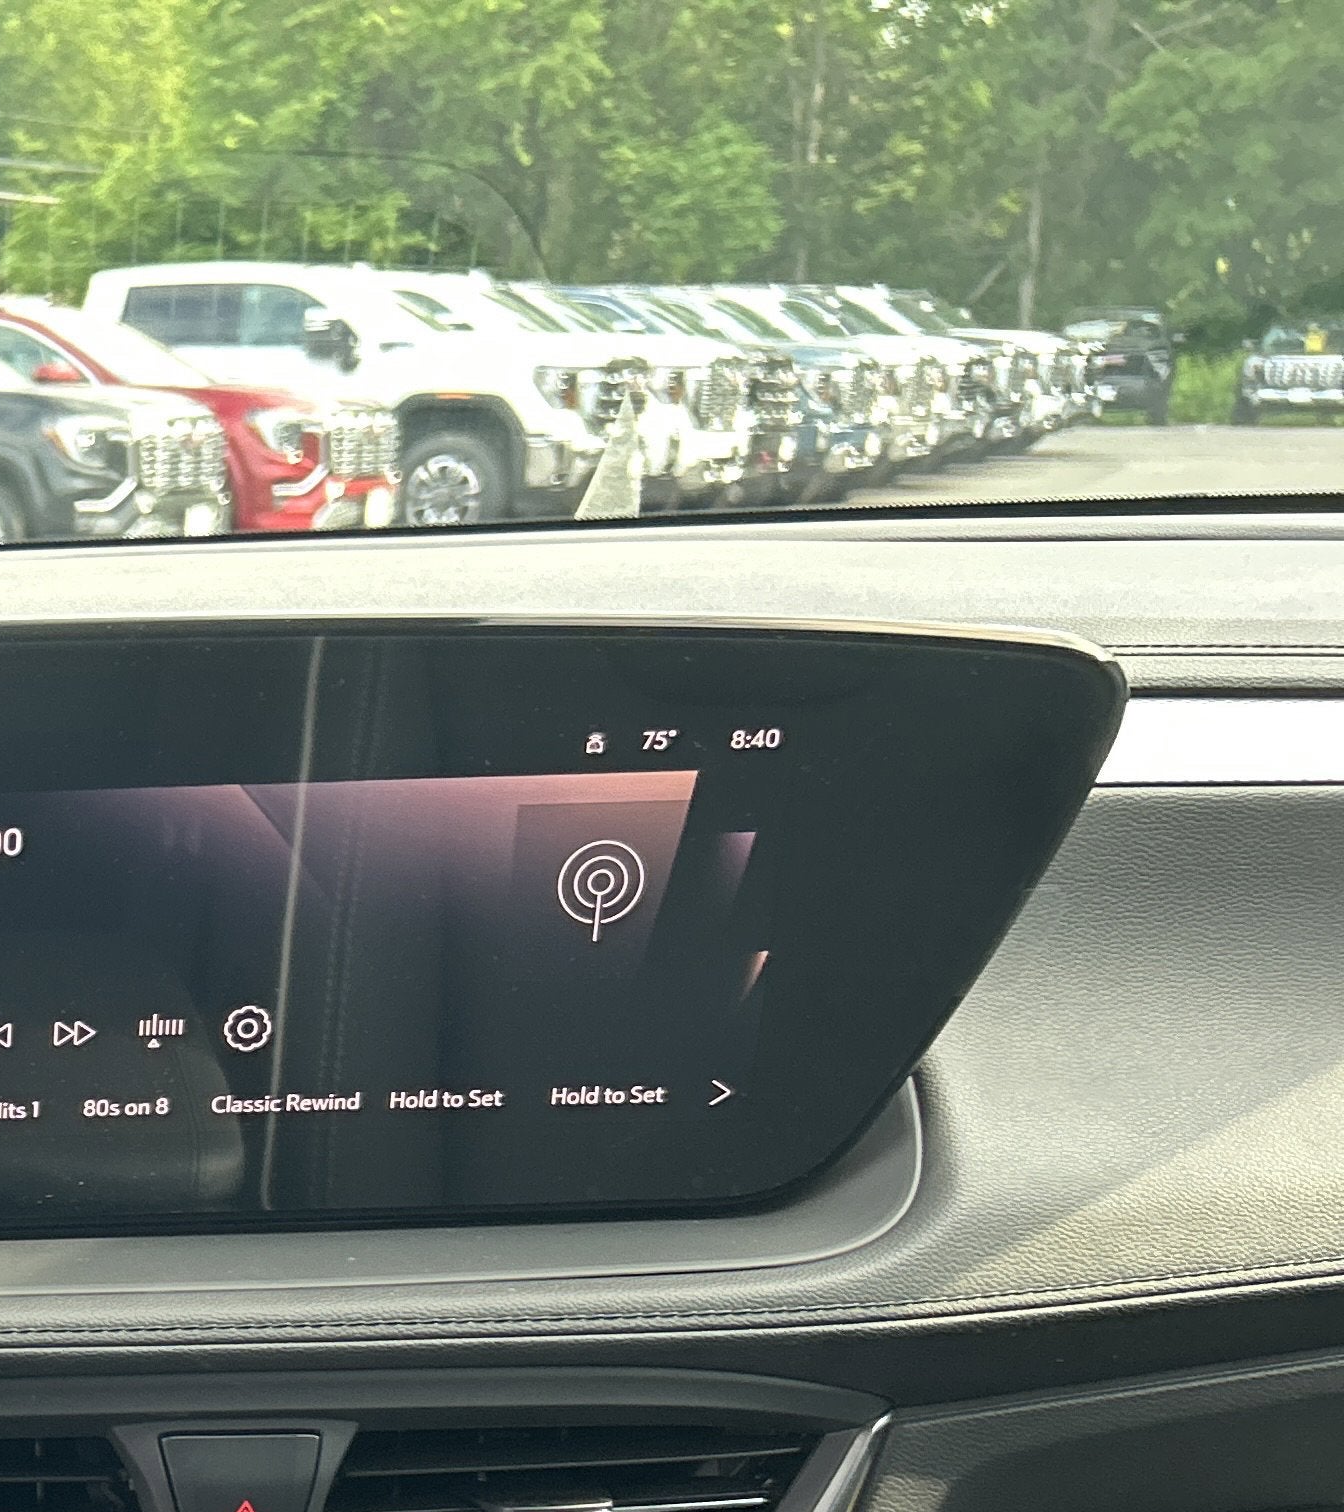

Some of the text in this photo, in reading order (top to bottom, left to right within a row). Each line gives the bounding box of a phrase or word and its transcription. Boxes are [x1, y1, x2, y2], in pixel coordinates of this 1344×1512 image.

[642, 729, 678, 750] 75°
[730, 728, 781, 750] 8:40
[211, 1092, 361, 1114] Classic Rewind
[389, 1089, 504, 1109] Hold to Set
[550, 1086, 665, 1105] Hold to Set
[31, 1101, 40, 1118] 1
[83, 1098, 169, 1117] 80s on 8
